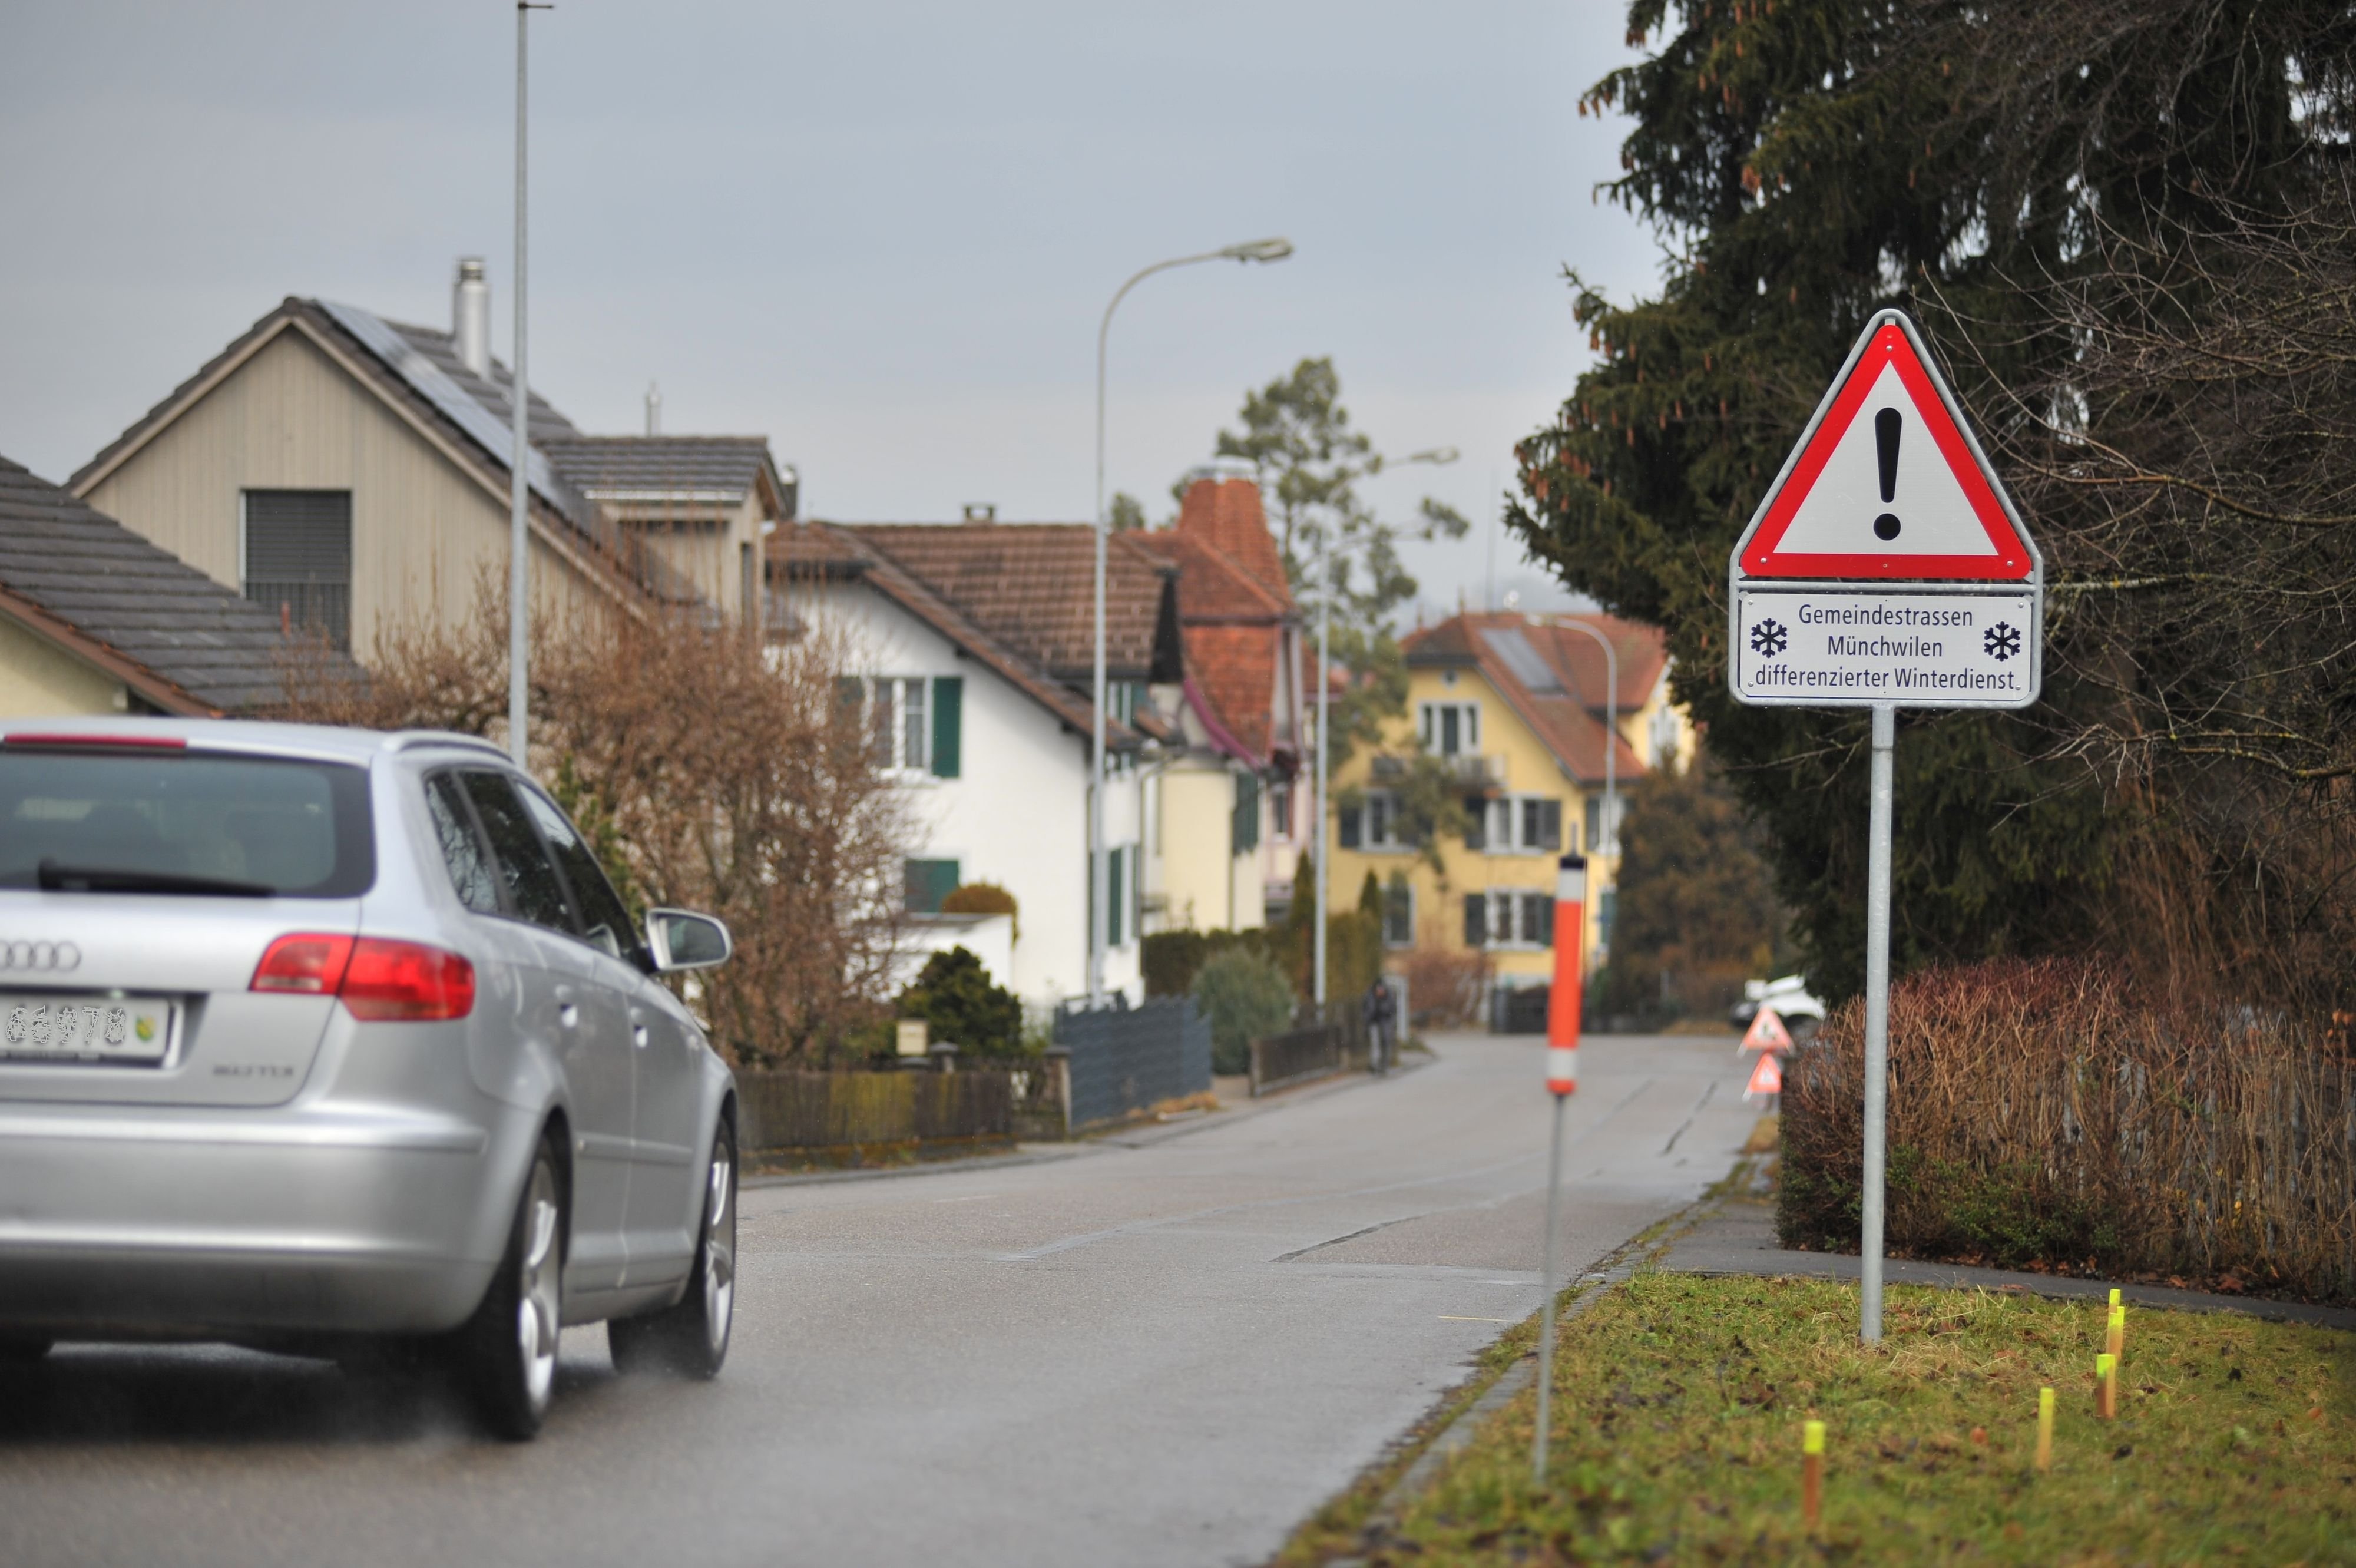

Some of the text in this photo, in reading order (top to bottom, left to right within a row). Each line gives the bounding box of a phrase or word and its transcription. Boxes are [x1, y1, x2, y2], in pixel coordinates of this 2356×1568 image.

[1798, 604, 1973, 626] Gemeindestrassen
[1827, 635, 1943, 657] Münchwilen
[1755, 664, 2014, 689] differenzierter Winterdienst
